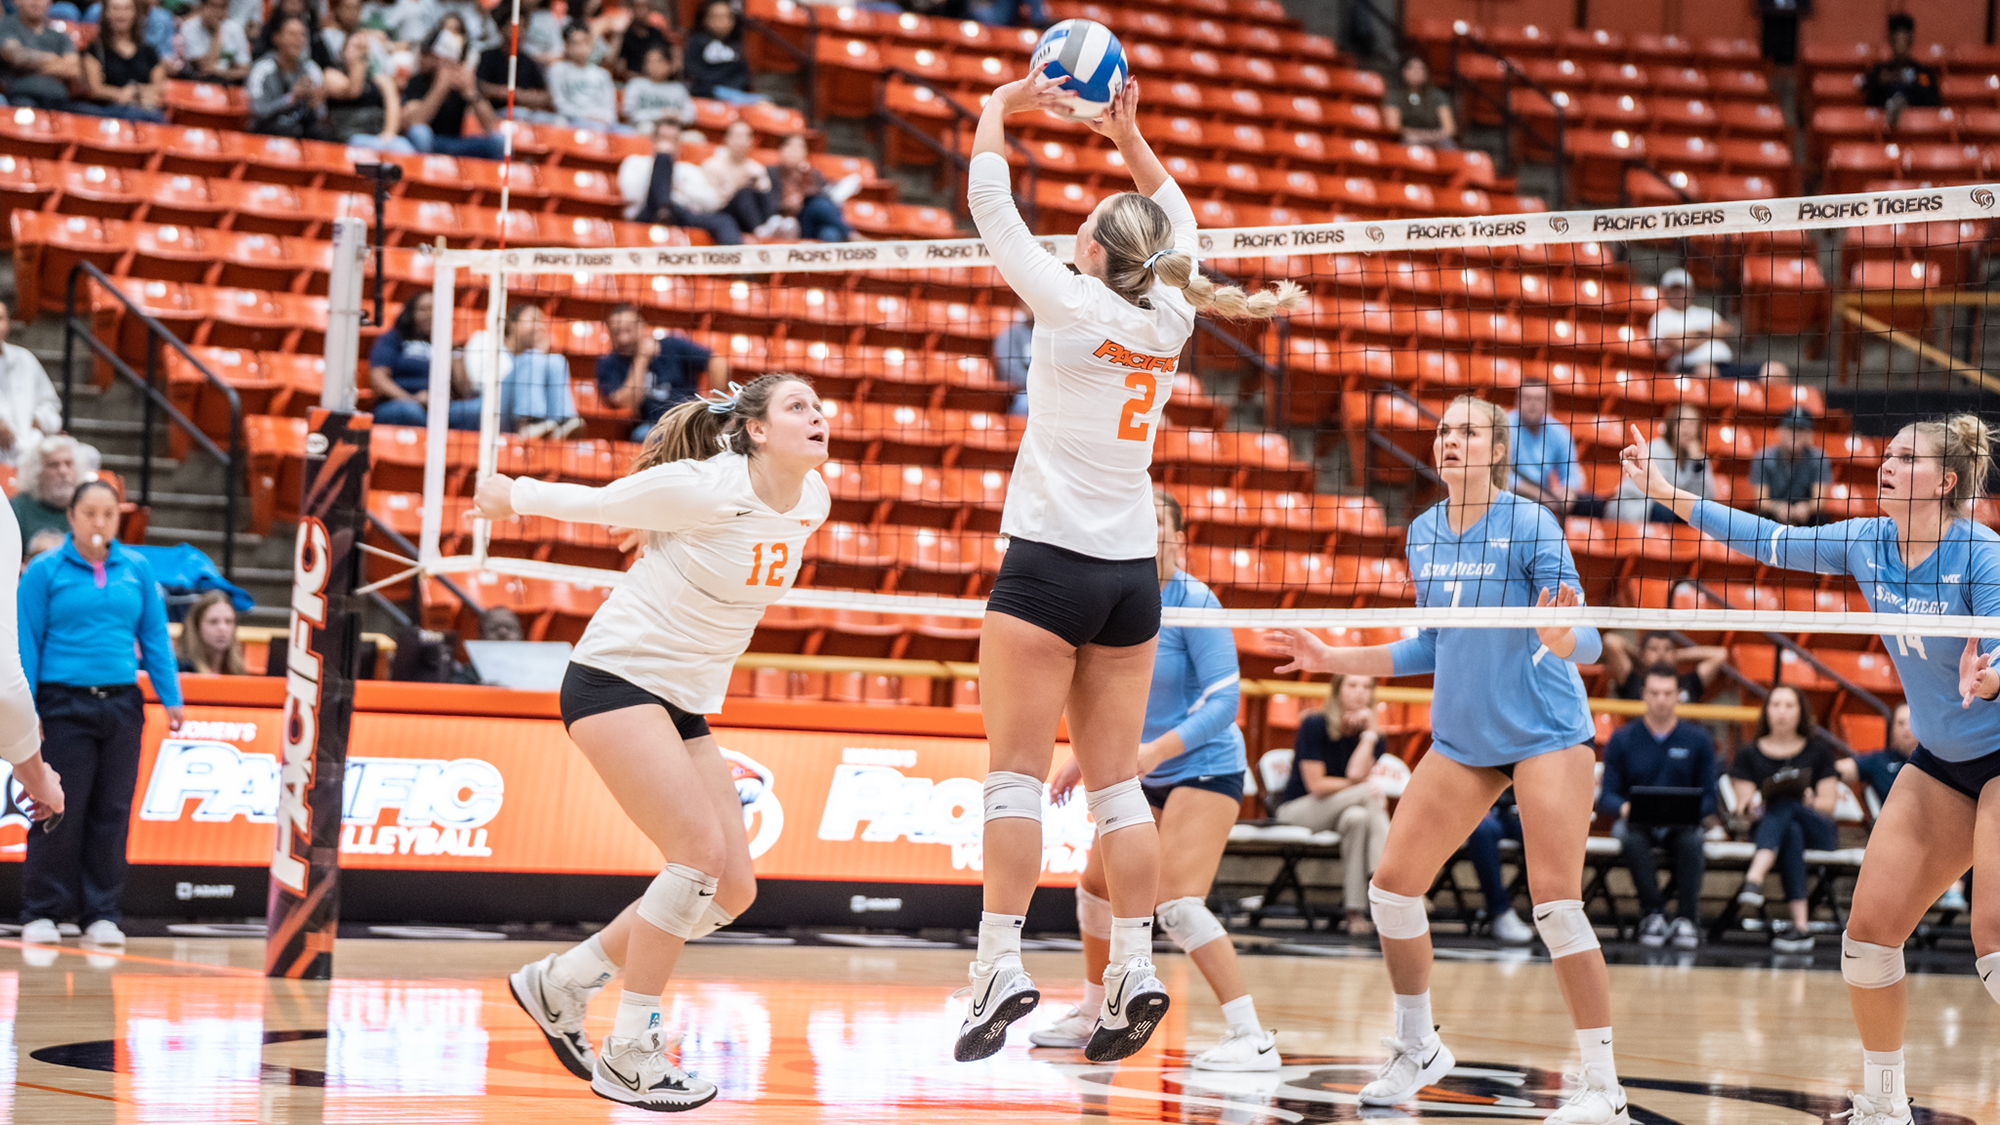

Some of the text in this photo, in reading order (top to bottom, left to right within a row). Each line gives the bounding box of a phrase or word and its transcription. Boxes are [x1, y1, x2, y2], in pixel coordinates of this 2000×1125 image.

[1798, 194, 1943, 221] PACIFIC TIGERS
[1406, 220, 1526, 241] PACIFIC TIGERS
[1592, 208, 1725, 233] PACIFIC TIGERS
[1233, 229, 1345, 249] PACIFIC TIGERS
[657, 251, 742, 265] PACIFIC TIGERS
[787, 248, 877, 263] PACIFIC TIGERS
[925, 244, 975, 259] PACIFIC
[1117, 371, 1157, 442] 2
[745, 542, 788, 587] 12
[1420, 561, 1497, 578] SAN DIEGO
[1941, 573, 1962, 584] WCC
[1443, 580, 1463, 608] 7
[1900, 597, 1949, 615] DIEGO
[271, 515, 332, 898] PACIFIC
[340, 824, 493, 858] LLEYBALL
[1137, 958, 1150, 968] 26
